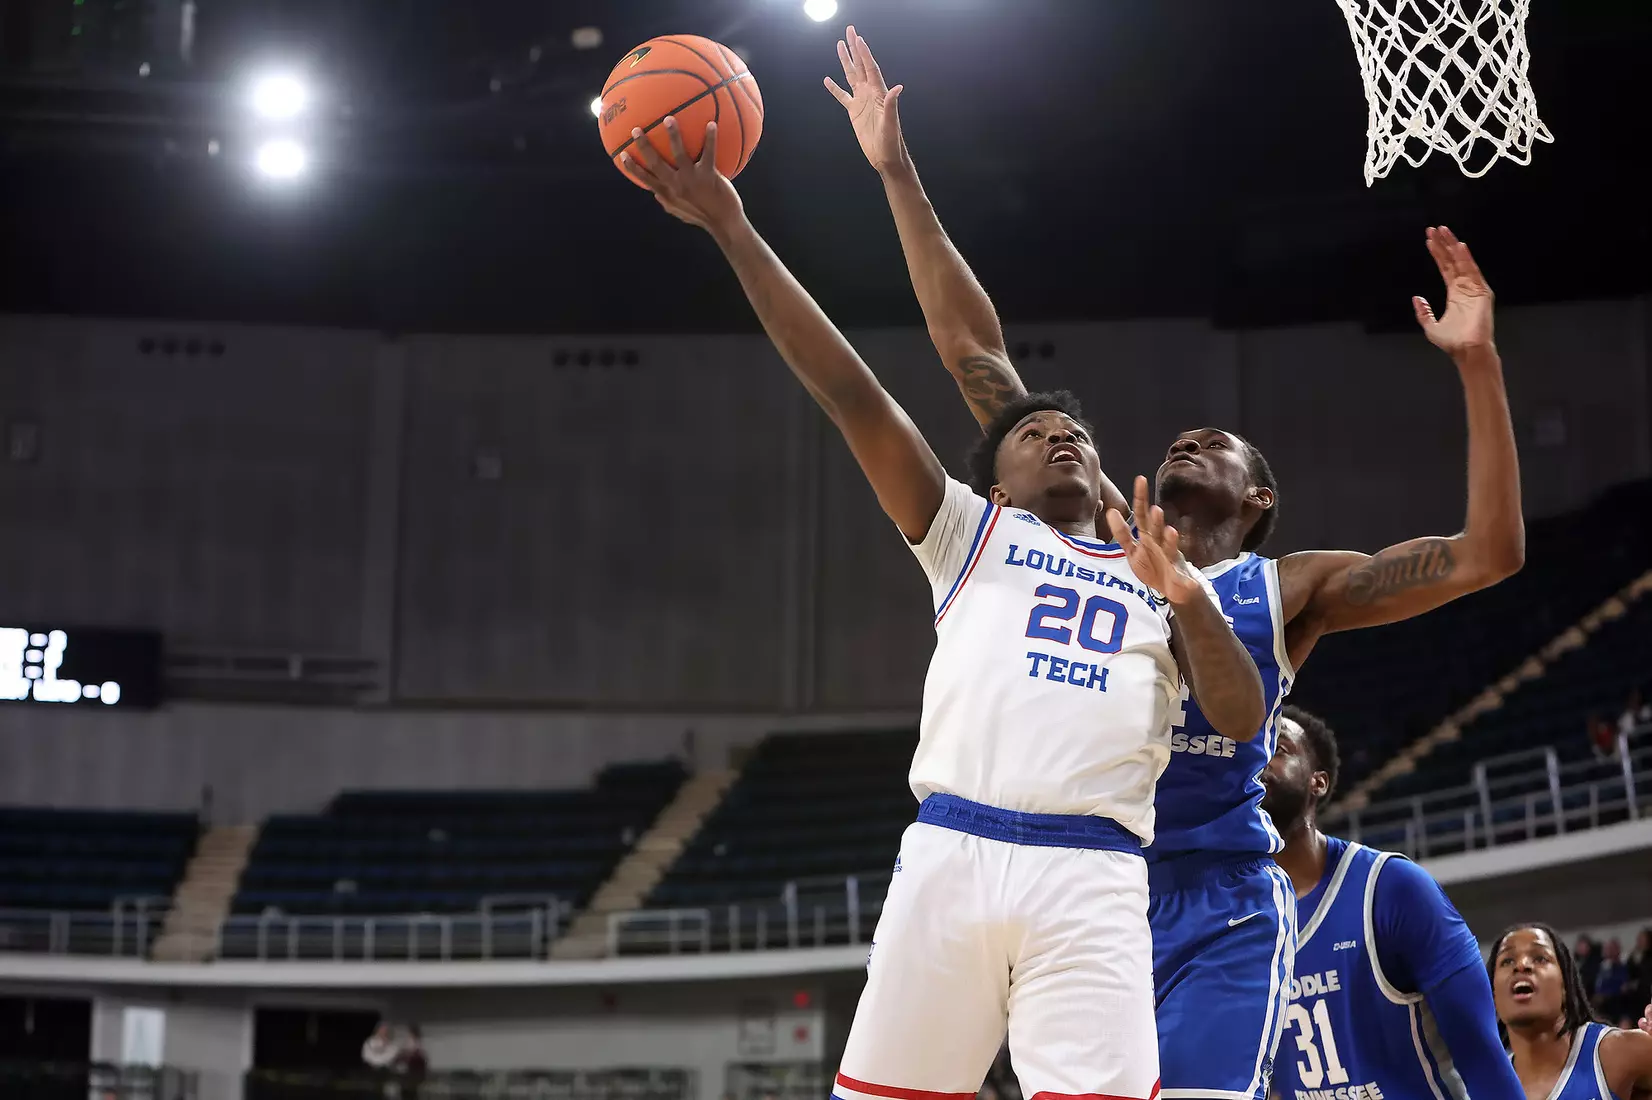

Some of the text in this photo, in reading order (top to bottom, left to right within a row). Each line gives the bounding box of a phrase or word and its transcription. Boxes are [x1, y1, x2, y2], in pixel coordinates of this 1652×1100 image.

[1025, 583, 1129, 655] 20
[1026, 652, 1110, 692] TECH
[1284, 999, 1350, 1088] 31
